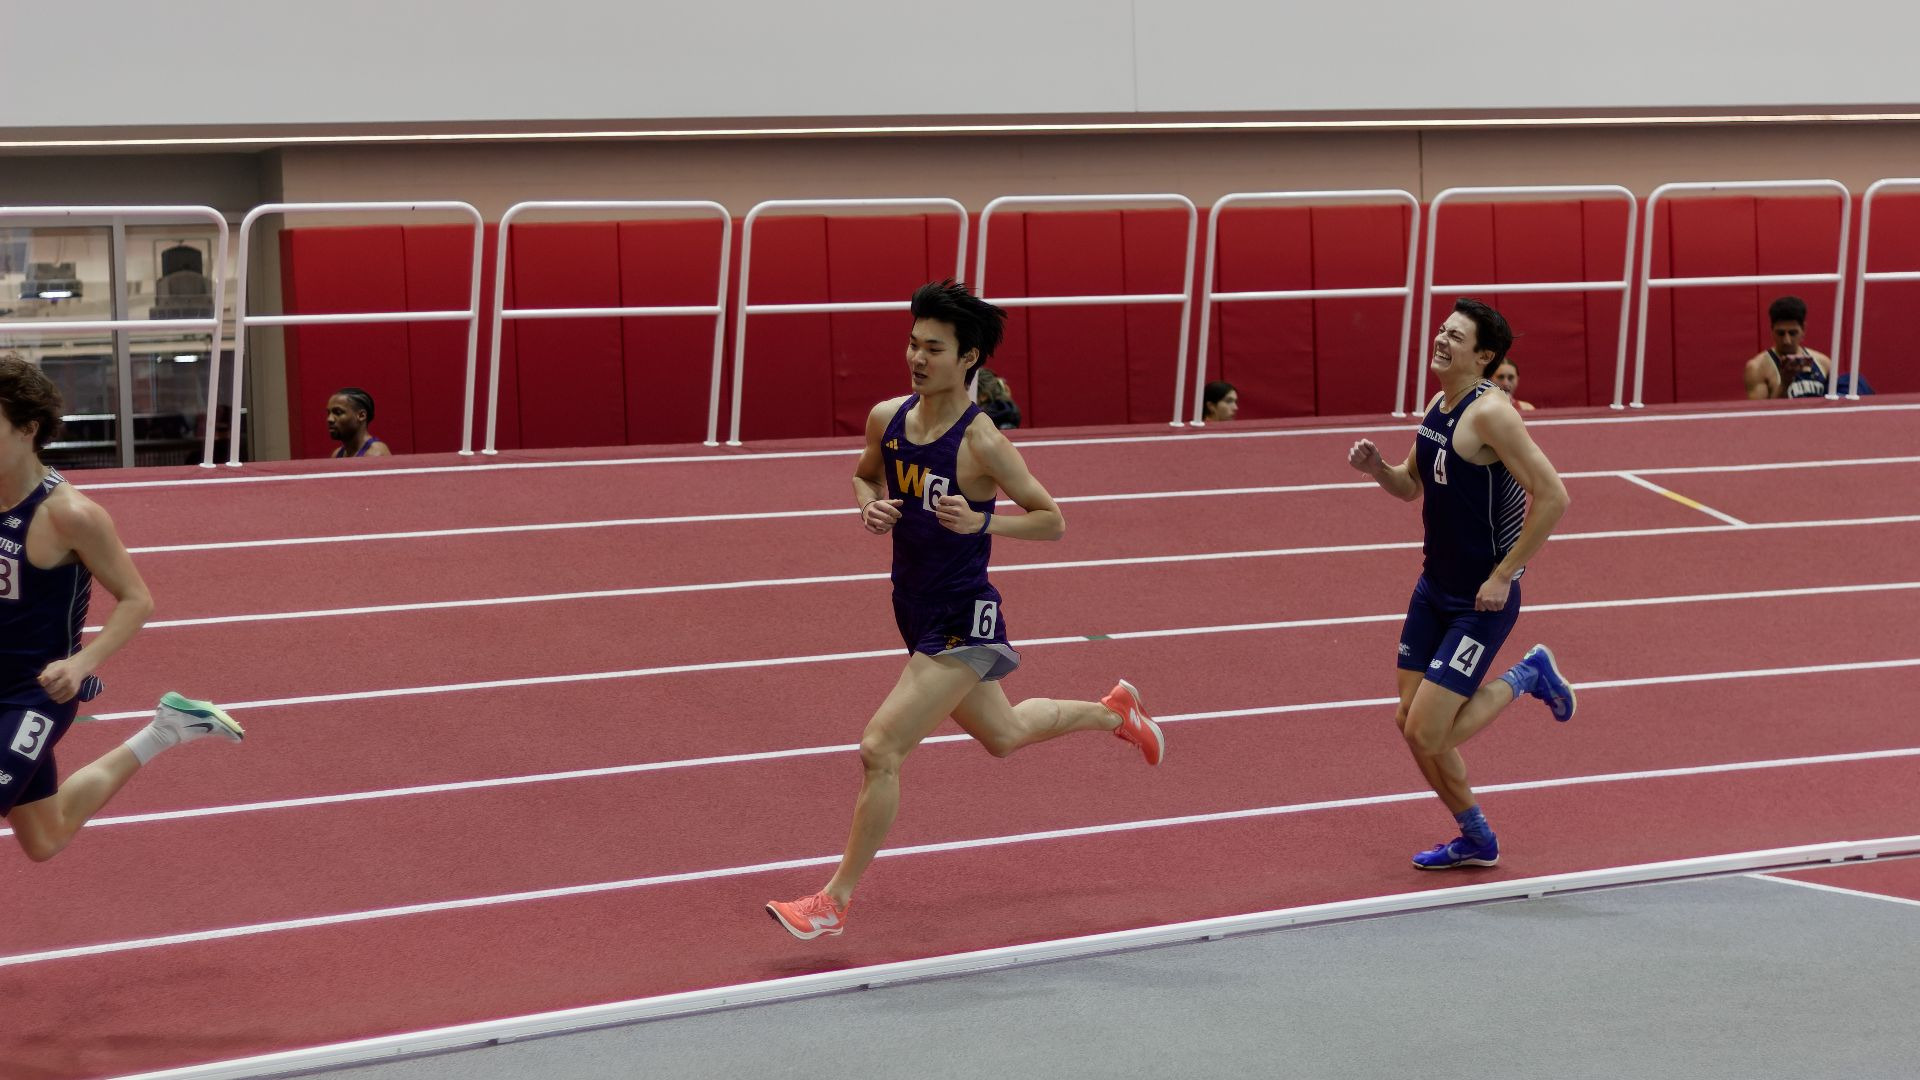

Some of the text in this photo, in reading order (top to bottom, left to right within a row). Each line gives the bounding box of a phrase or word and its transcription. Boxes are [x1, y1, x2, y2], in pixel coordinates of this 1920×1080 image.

[896, 460, 931, 498] W
[1436, 451, 1443, 482] 4
[929, 478, 943, 510] 6
[979, 603, 993, 636] 6
[1457, 643, 1479, 672] 4
[18, 716, 46, 754] 3
